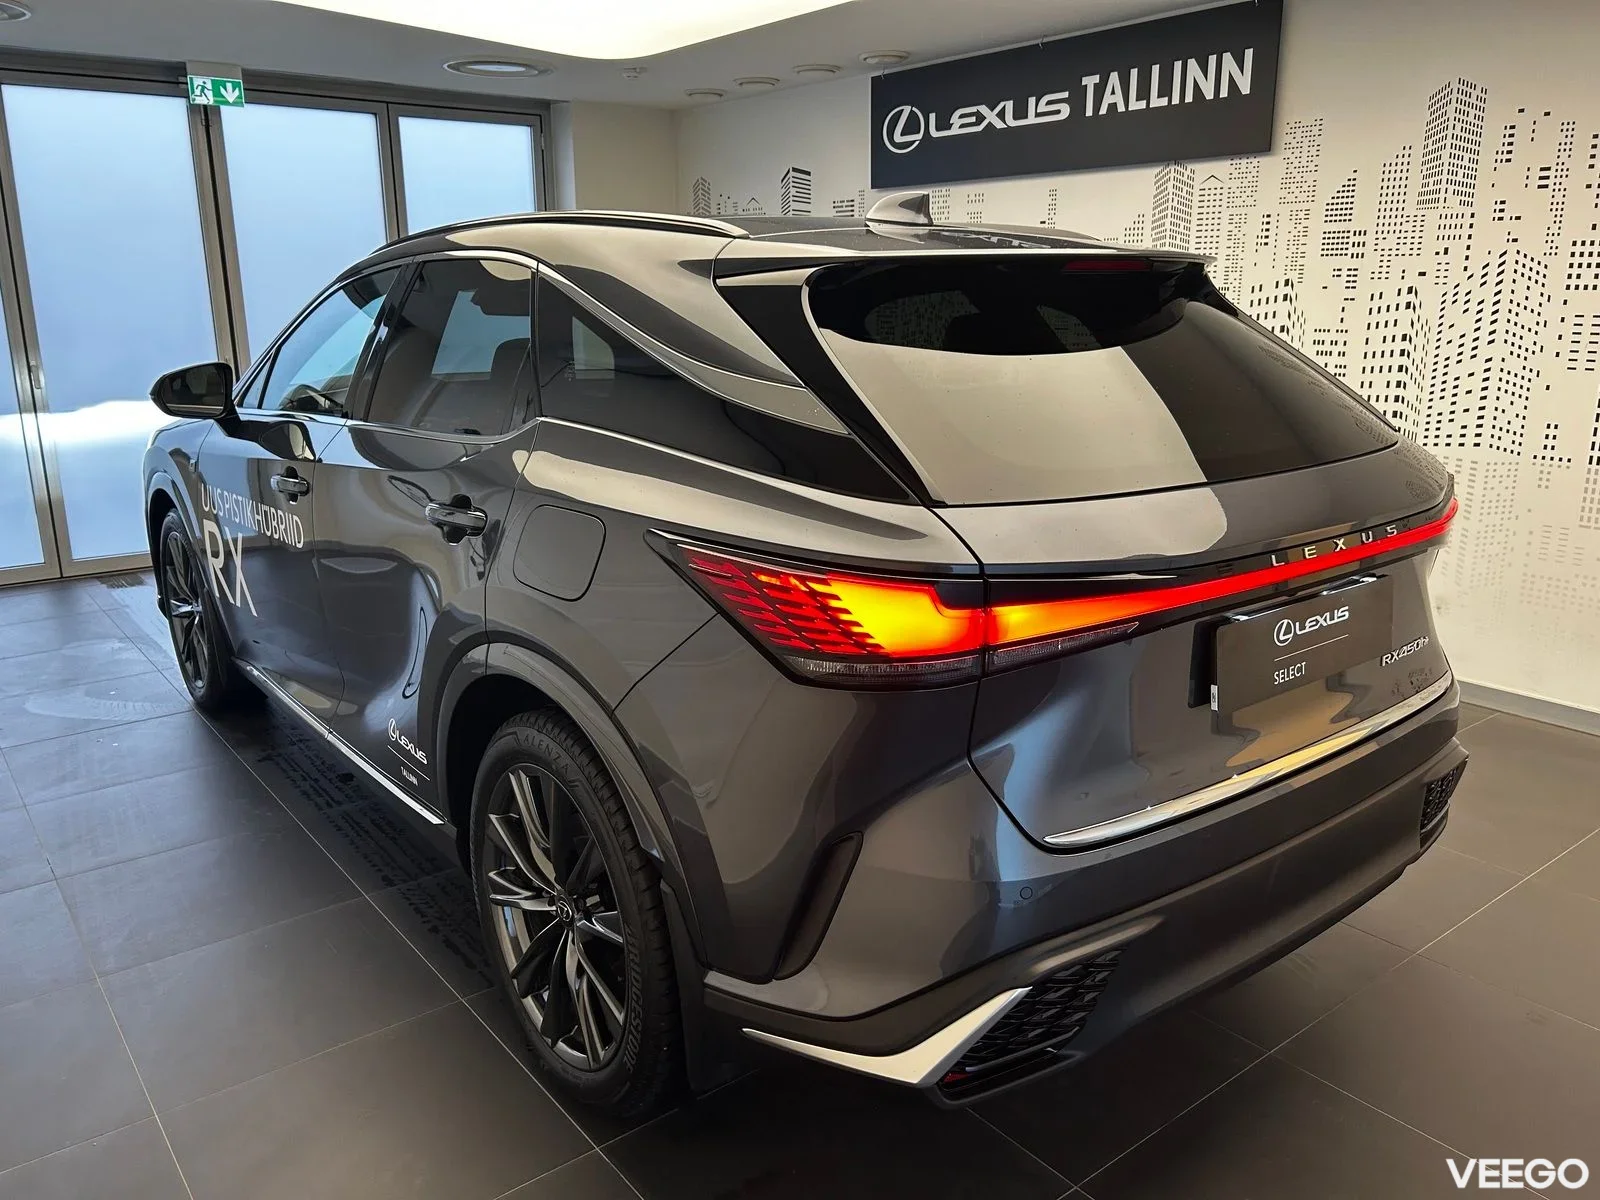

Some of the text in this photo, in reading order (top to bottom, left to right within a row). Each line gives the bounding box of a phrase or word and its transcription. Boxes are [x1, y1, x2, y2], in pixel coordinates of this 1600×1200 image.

[929, 48, 1254, 138] LEXUS TALLINN
[1271, 525, 1398, 567] LEXUS
[203, 519, 258, 617] RX
[1295, 606, 1349, 635] LEXUS
[1274, 661, 1306, 685] SELECT
[396, 730, 428, 765] LEXUS
[523, 733, 570, 775] ALENZA
[400, 766, 419, 786] TALLINN
[623, 923, 644, 1074] BRIDGESTONE
